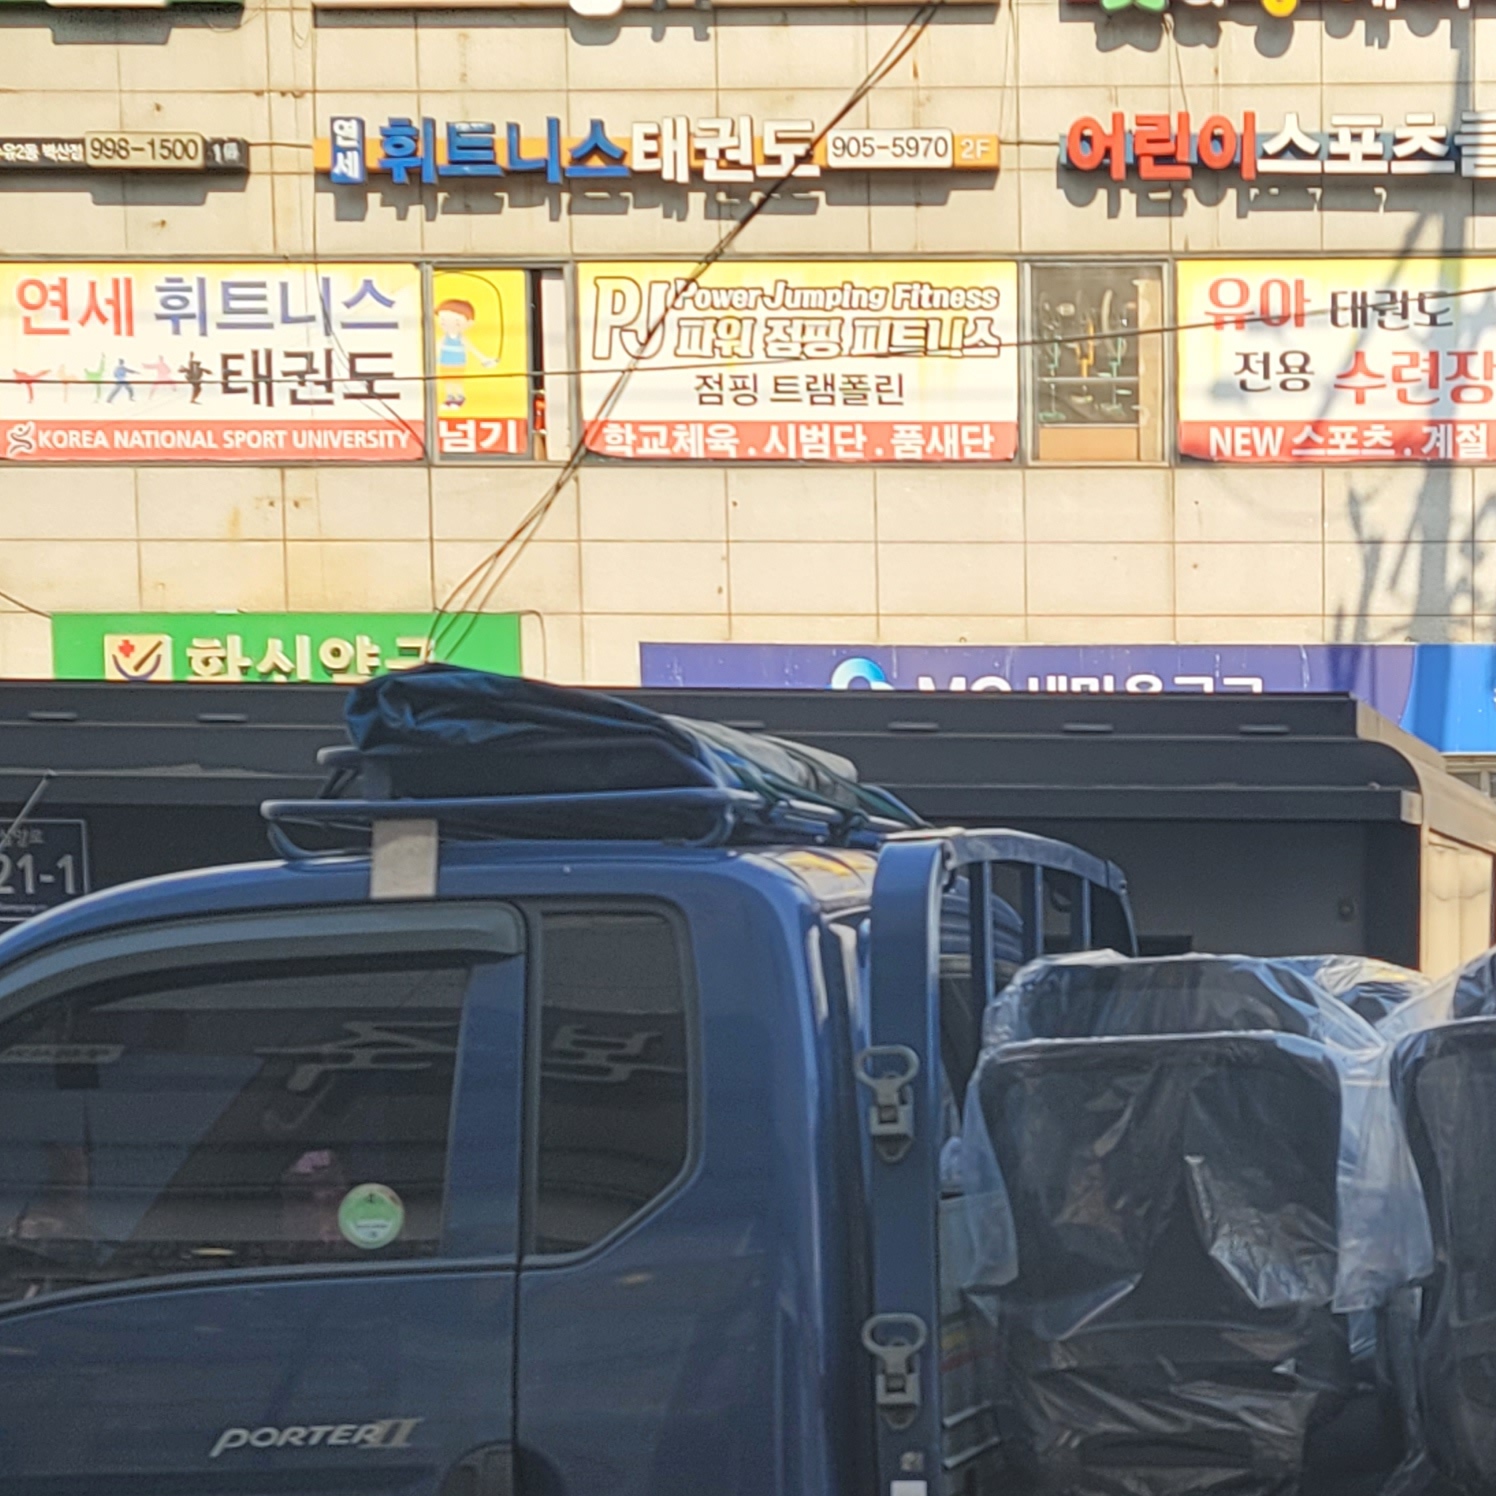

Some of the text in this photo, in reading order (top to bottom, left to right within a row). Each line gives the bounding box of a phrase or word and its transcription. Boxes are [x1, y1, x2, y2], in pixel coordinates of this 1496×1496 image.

[90, 137, 199, 160] 998-1500
[831, 136, 949, 159] 905-5970
[960, 139, 990, 160] 2F
[16, 276, 400, 337] 연세 휘트니스
[673, 278, 1000, 311] Power Jumping Fitness
[1204, 278, 1453, 331] 유아 태권도
[592, 276, 671, 360] PJ
[674, 316, 1001, 360] 파워 점핑 피트니스
[219, 347, 401, 407] 태권도
[694, 372, 906, 406] 점핑 트램폴린
[1233, 350, 1315, 392] 전용
[37, 429, 411, 449] KOREA NATIONAL SPORT UNIVERSITY
[440, 419, 518, 454] 넘기
[889, 422, 994, 459] 품새단
[1209, 427, 1284, 457] NEW
[1421, 423, 1488, 459] 계절
